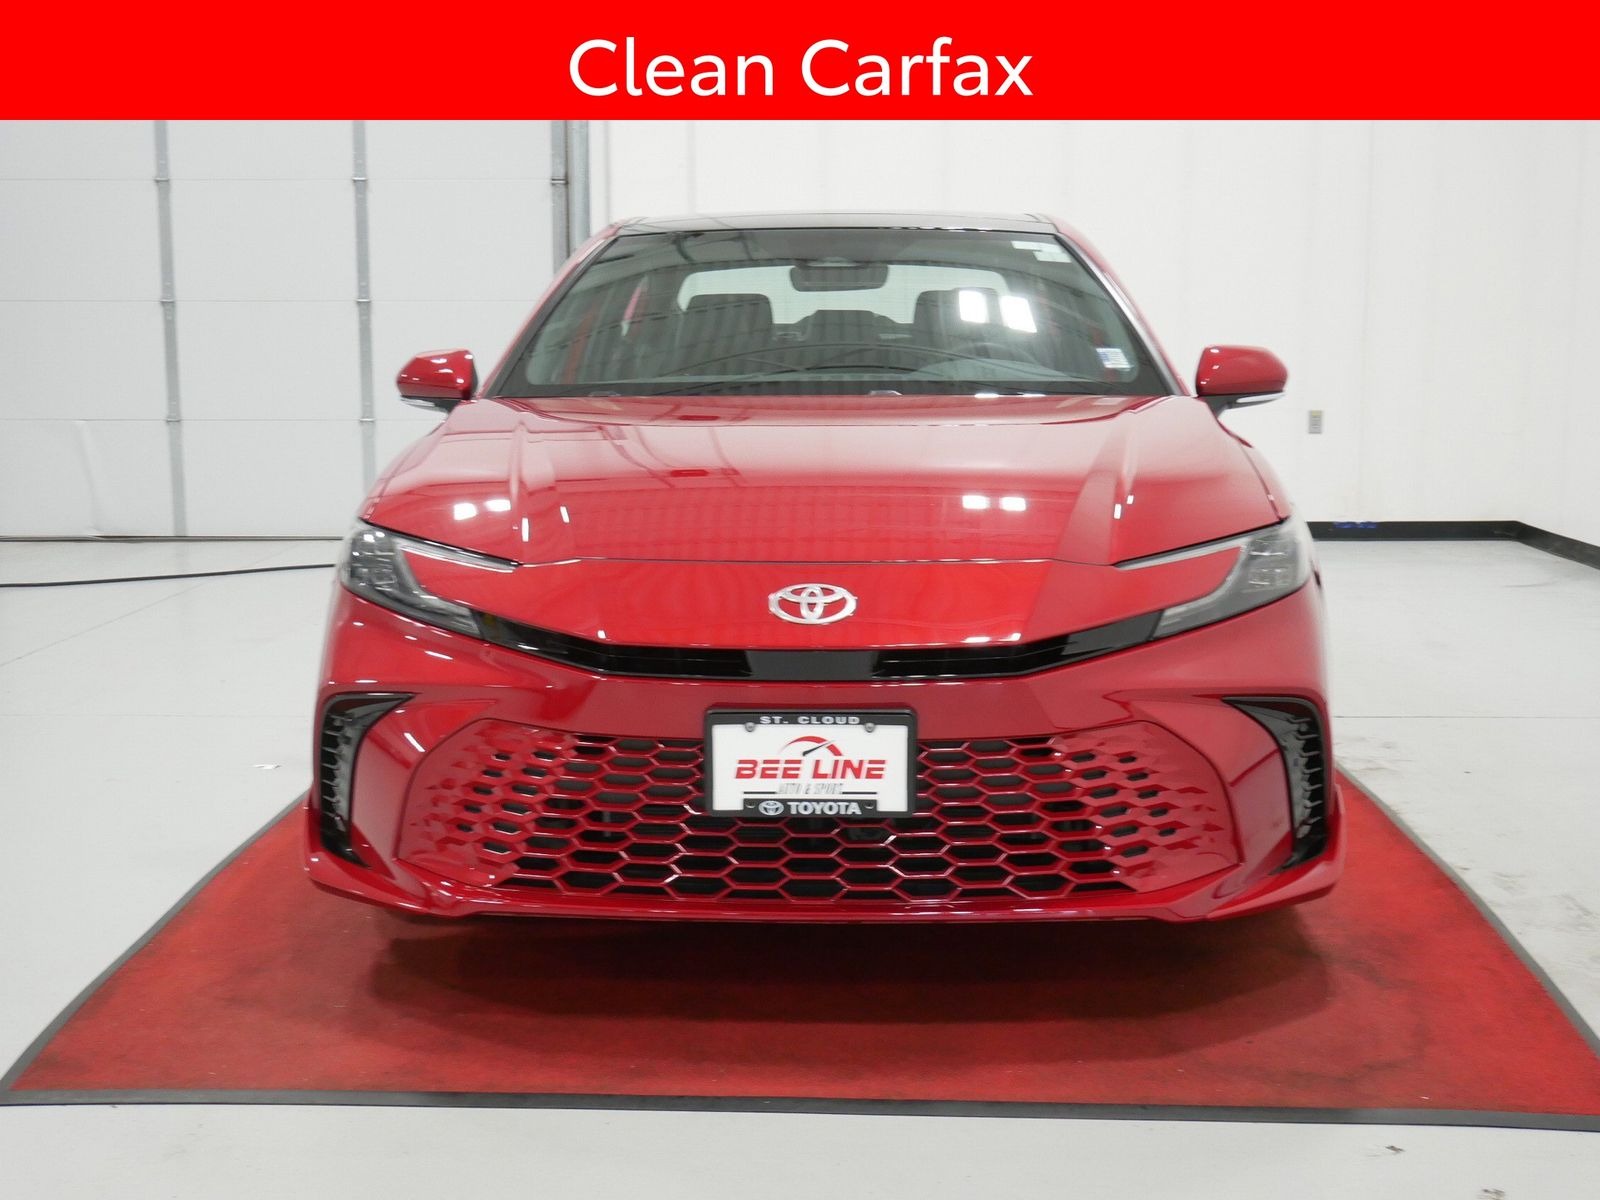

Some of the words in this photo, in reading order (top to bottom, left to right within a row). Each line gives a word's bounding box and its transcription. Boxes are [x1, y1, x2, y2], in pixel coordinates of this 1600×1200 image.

[759, 716, 789, 725] ST.
[797, 716, 861, 725] CLOUD
[735, 759, 803, 779] BEE
[811, 759, 886, 779] LINE
[787, 801, 862, 815] TOYOTA
